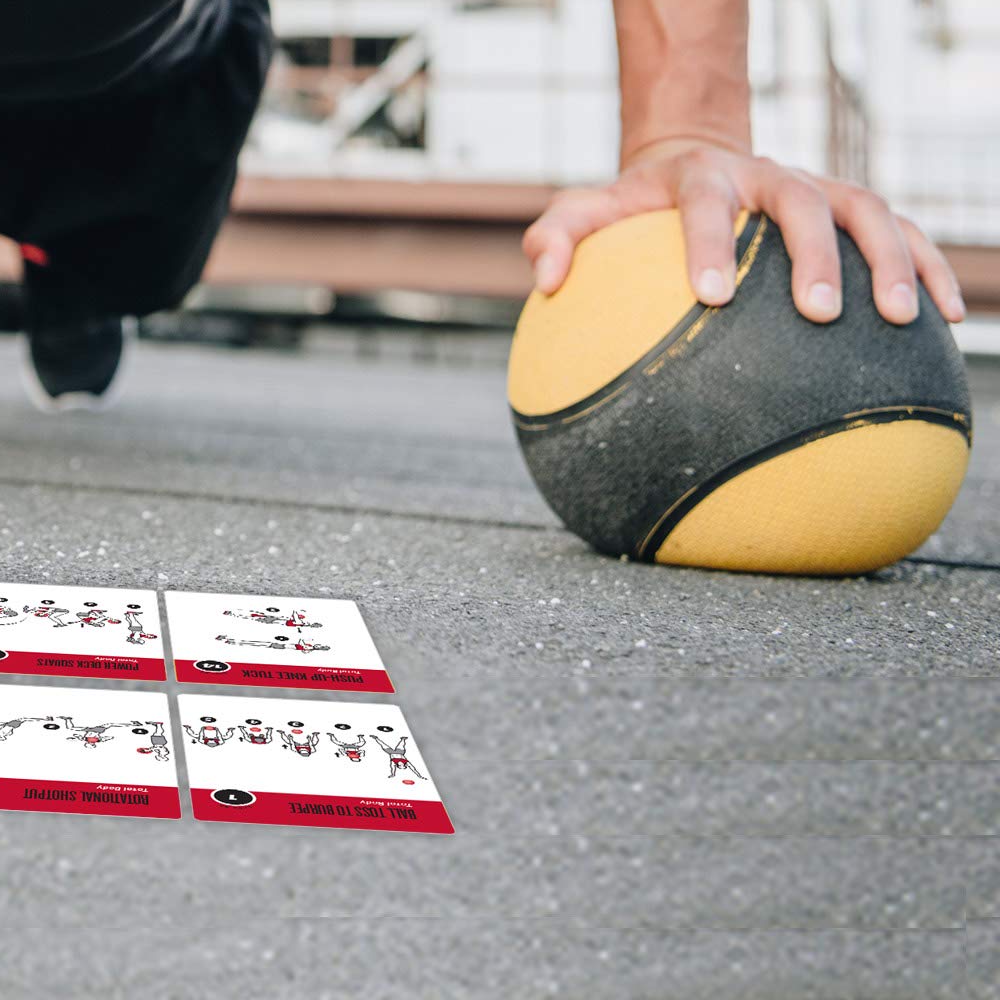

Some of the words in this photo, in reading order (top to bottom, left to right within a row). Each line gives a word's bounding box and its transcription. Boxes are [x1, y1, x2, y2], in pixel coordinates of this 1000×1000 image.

[36, 658, 74, 667] SQUATS
[77, 660, 101, 668] DECK
[104, 662, 139, 671] POWER
[241, 670, 273, 679] TUCK
[276, 672, 307, 680] KNEE
[311, 674, 364, 683] PUSH-UP
[23, 789, 77, 800] SHOTPUT
[81, 792, 149, 805] ROTATIONAL
[288, 803, 335, 814] BURPEE
[336, 805, 352, 816] TO
[354, 807, 386, 817] TOSS
[387, 808, 417, 819] BALL
